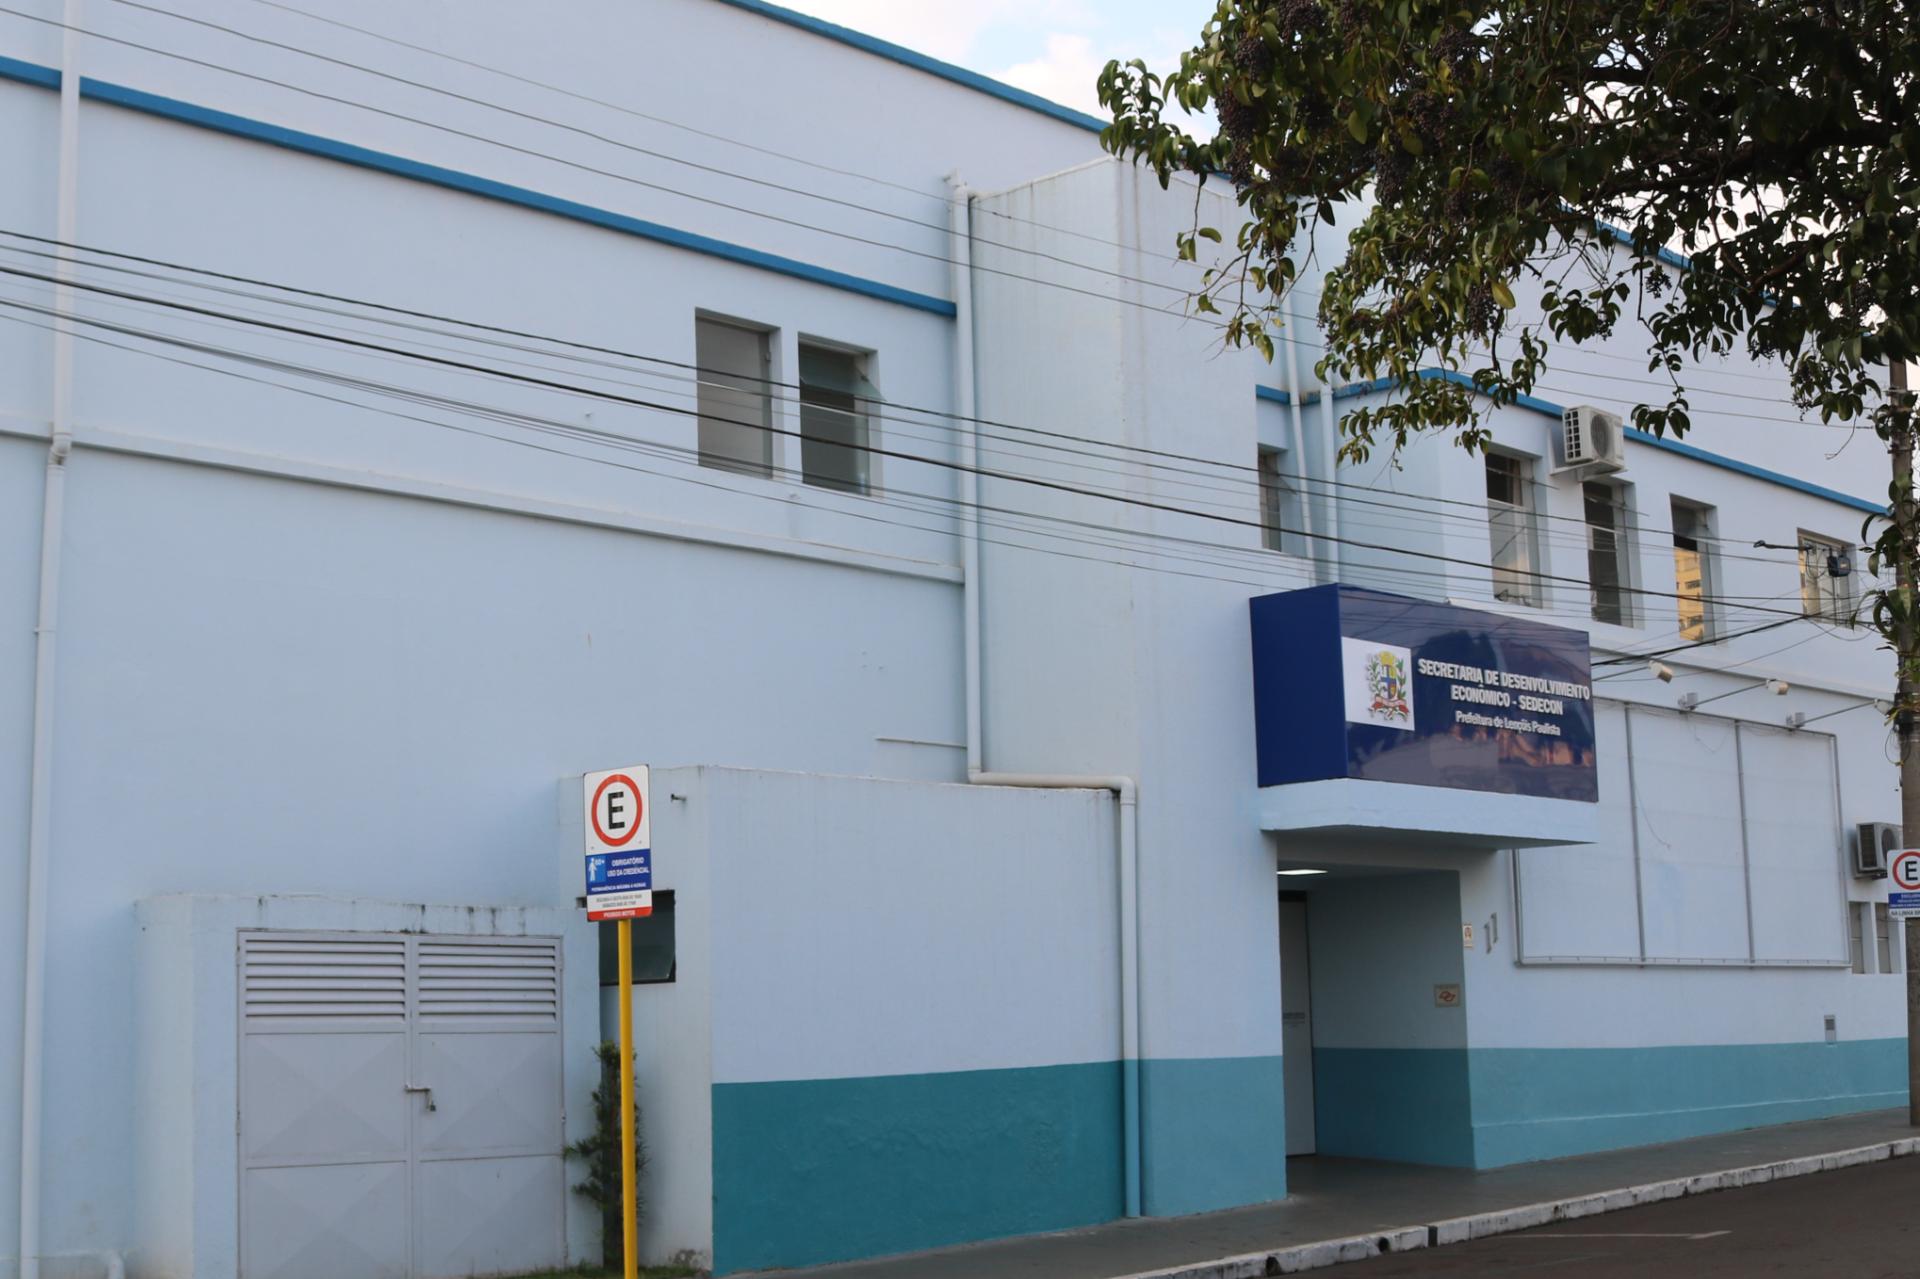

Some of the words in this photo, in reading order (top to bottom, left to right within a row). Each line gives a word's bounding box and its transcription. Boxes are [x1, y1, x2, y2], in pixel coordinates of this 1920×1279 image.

[1418, 658, 1484, 683] SECRETARIA
[1484, 670, 1500, 684] DE
[1501, 672, 1590, 700] DESENVOLVIMENTO
[1451, 684, 1510, 707] ECONÔMICO
[1519, 695, 1563, 715] SEDECON
[1455, 710, 1493, 726] Prefeitura
[1493, 716, 1504, 728] de
[1532, 720, 1561, 736] Paulista
[608, 791, 625, 830] E
[1905, 861, 1918, 881] E
